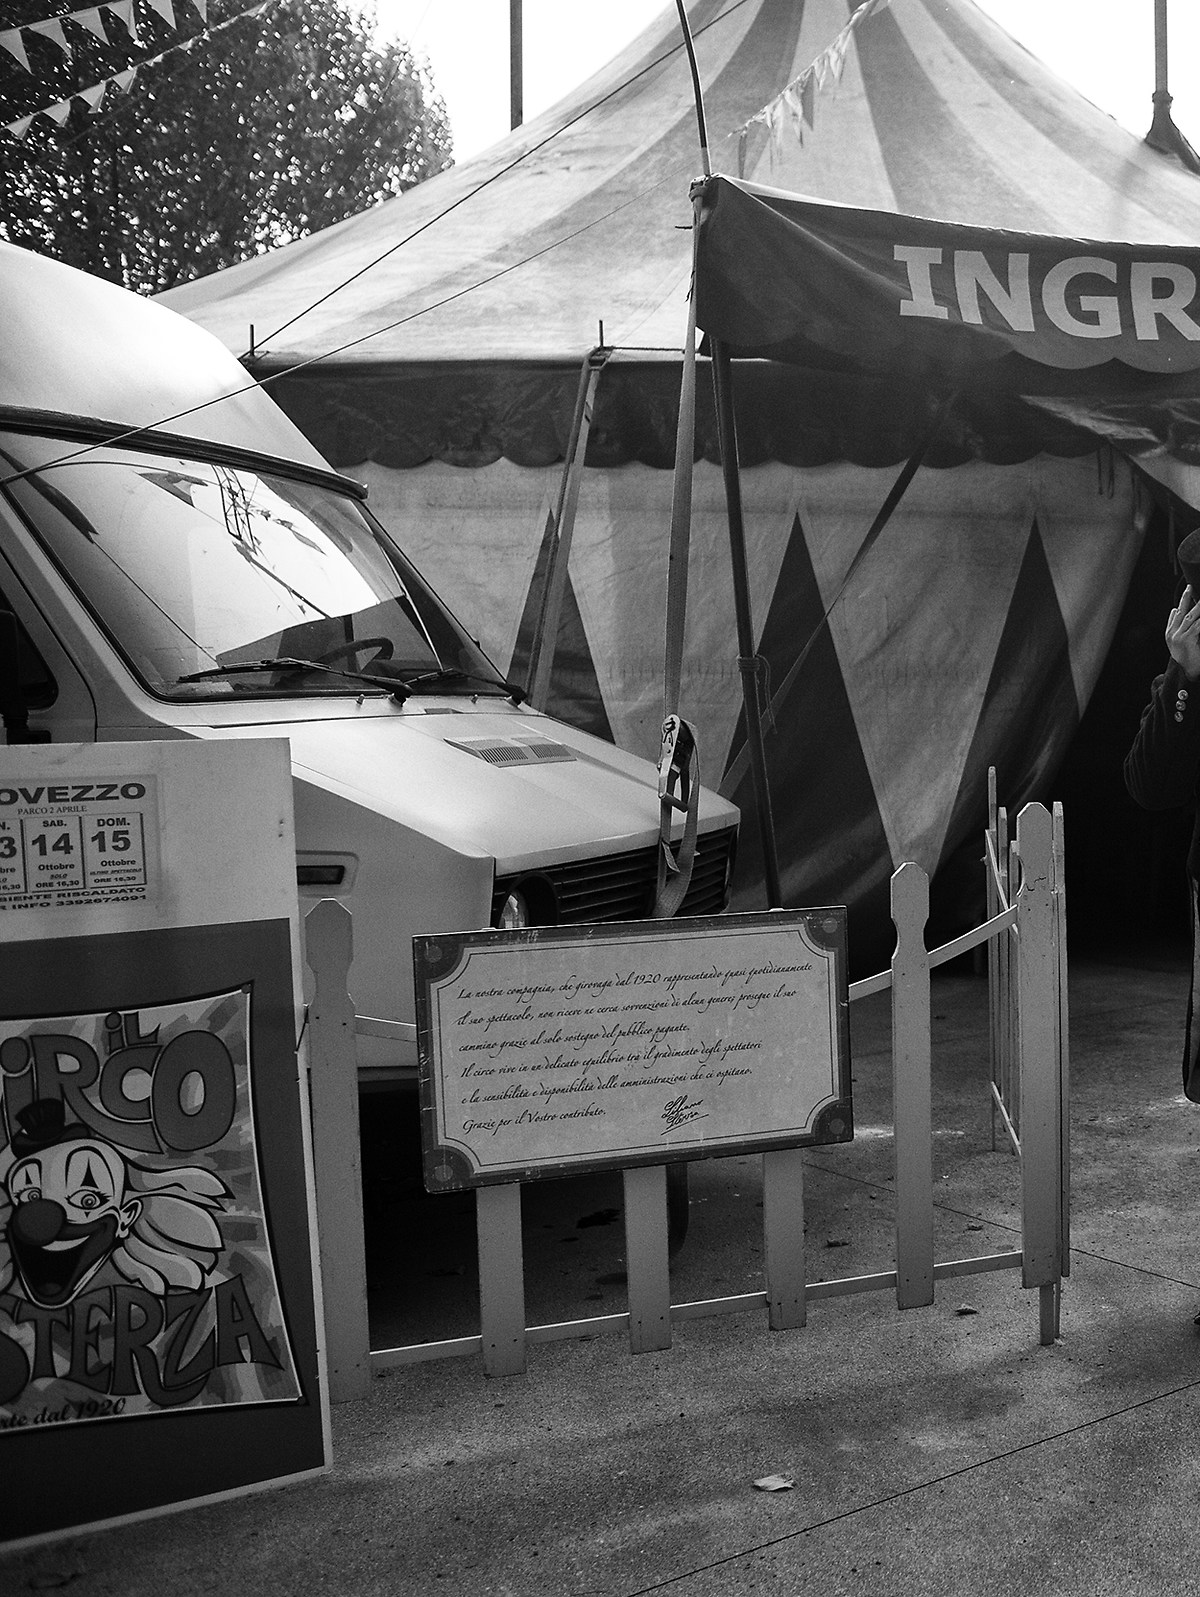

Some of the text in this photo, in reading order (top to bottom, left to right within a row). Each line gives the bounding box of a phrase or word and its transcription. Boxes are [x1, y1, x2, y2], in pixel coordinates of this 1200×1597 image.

[0, 782, 146, 806] OVEZZO
[17, 805, 88, 815] PARCO 2 APRILE
[42, 819, 67, 828] SAB.
[97, 817, 131, 827] DOM.
[31, 832, 74, 856] 14
[91, 830, 131, 853] 15
[38, 863, 75, 871] Ottobre
[100, 859, 136, 867] Ottobre
[35, 881, 55, 889] ORE
[57, 887, 146, 899] RISCALDATO
[12, 901, 51, 910] INFO
[457, 960, 813, 1003] La nostra compagnia, che girovaga dal 1920 rappresentando quasi quotidianamente
[484, 1005, 534, 1032] spettacolo,
[537, 1010, 554, 1019] non
[557, 1008, 583, 1017] riceve
[597, 1005, 618, 1014] cerca
[620, 1000, 670, 1012] sovvenzioni
[671, 994, 681, 1007] di
[682, 991, 706, 1006] alcun
[733, 992, 771, 1010] prosegue
[772, 983, 786, 998] il
[782, 990, 797, 998] suo
[458, 1021, 690, 1058] cammino grazie al solo sostegno del pubblico pagante.
[643, 1044, 657, 1060] il
[643, 1044, 700, 1069] gradimento
[698, 1039, 723, 1064] degli
[720, 1040, 763, 1061] spettatori
[460, 1062, 476, 1078] Il
[498, 1064, 517, 1075] vive
[518, 1062, 529, 1072] in
[531, 1064, 543, 1072] un
[544, 1054, 579, 1070] delicato
[582, 1049, 624, 1075] equilibrio
[473, 1066, 496, 1077] circo
[469, 1088, 481, 1104] la
[597, 1074, 618, 1090] delle
[619, 1072, 688, 1087] amministrazioni
[690, 1064, 707, 1081] che
[706, 1069, 715, 1078] ci
[716, 1067, 753, 1086] ospitano.
[462, 1102, 606, 1136] Grazie per il Vostro contributo.
[33, 1403, 71, 1425] dal
[76, 1397, 126, 1419] 1920
